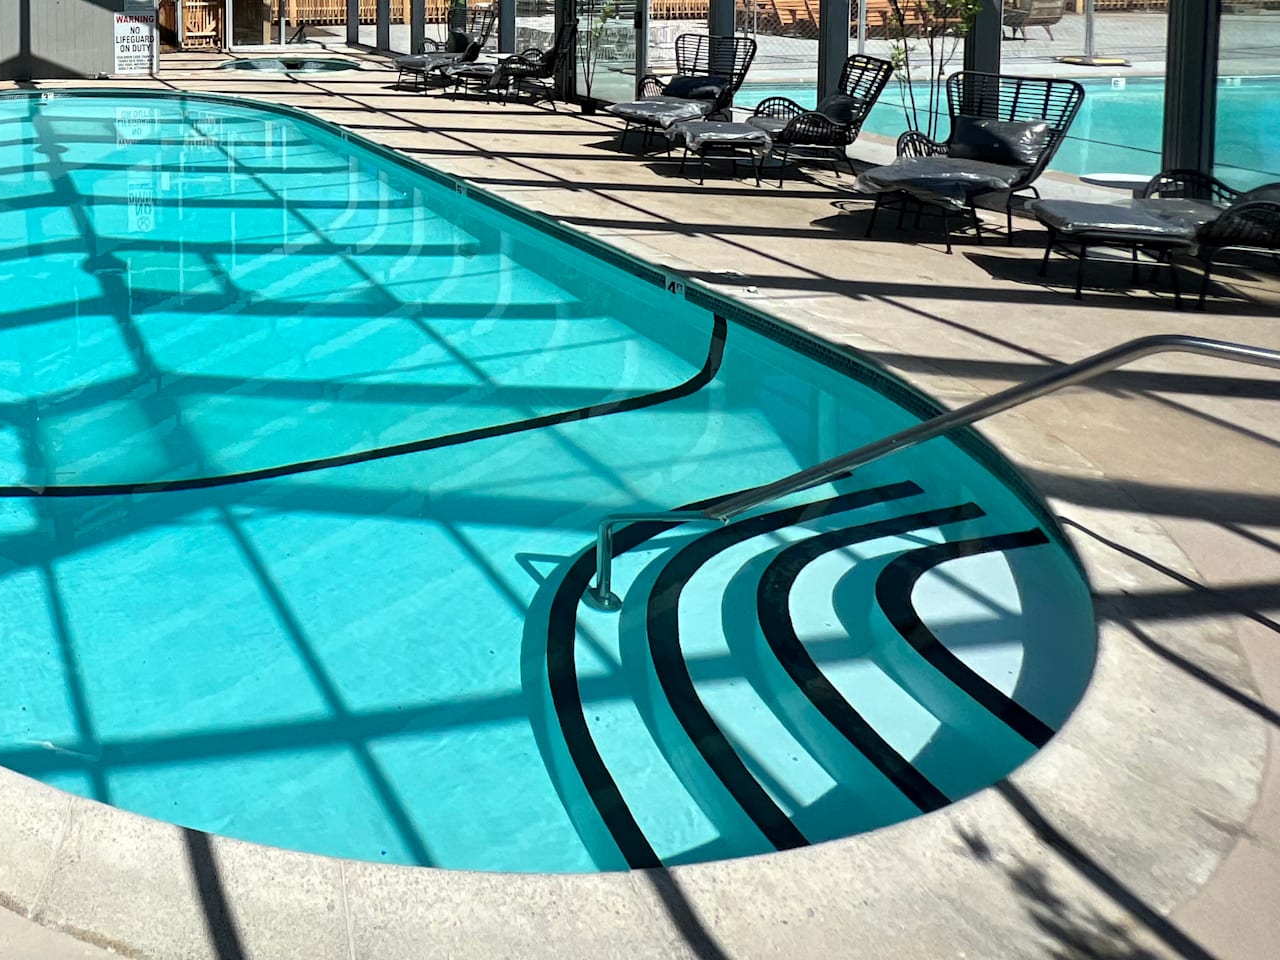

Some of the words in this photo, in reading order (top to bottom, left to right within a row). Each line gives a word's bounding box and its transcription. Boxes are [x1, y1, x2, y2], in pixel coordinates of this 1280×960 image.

[130, 26, 140, 34] NO
[116, 35, 154, 43] LIFEGUARD
[132, 44, 150, 52] DUTY
